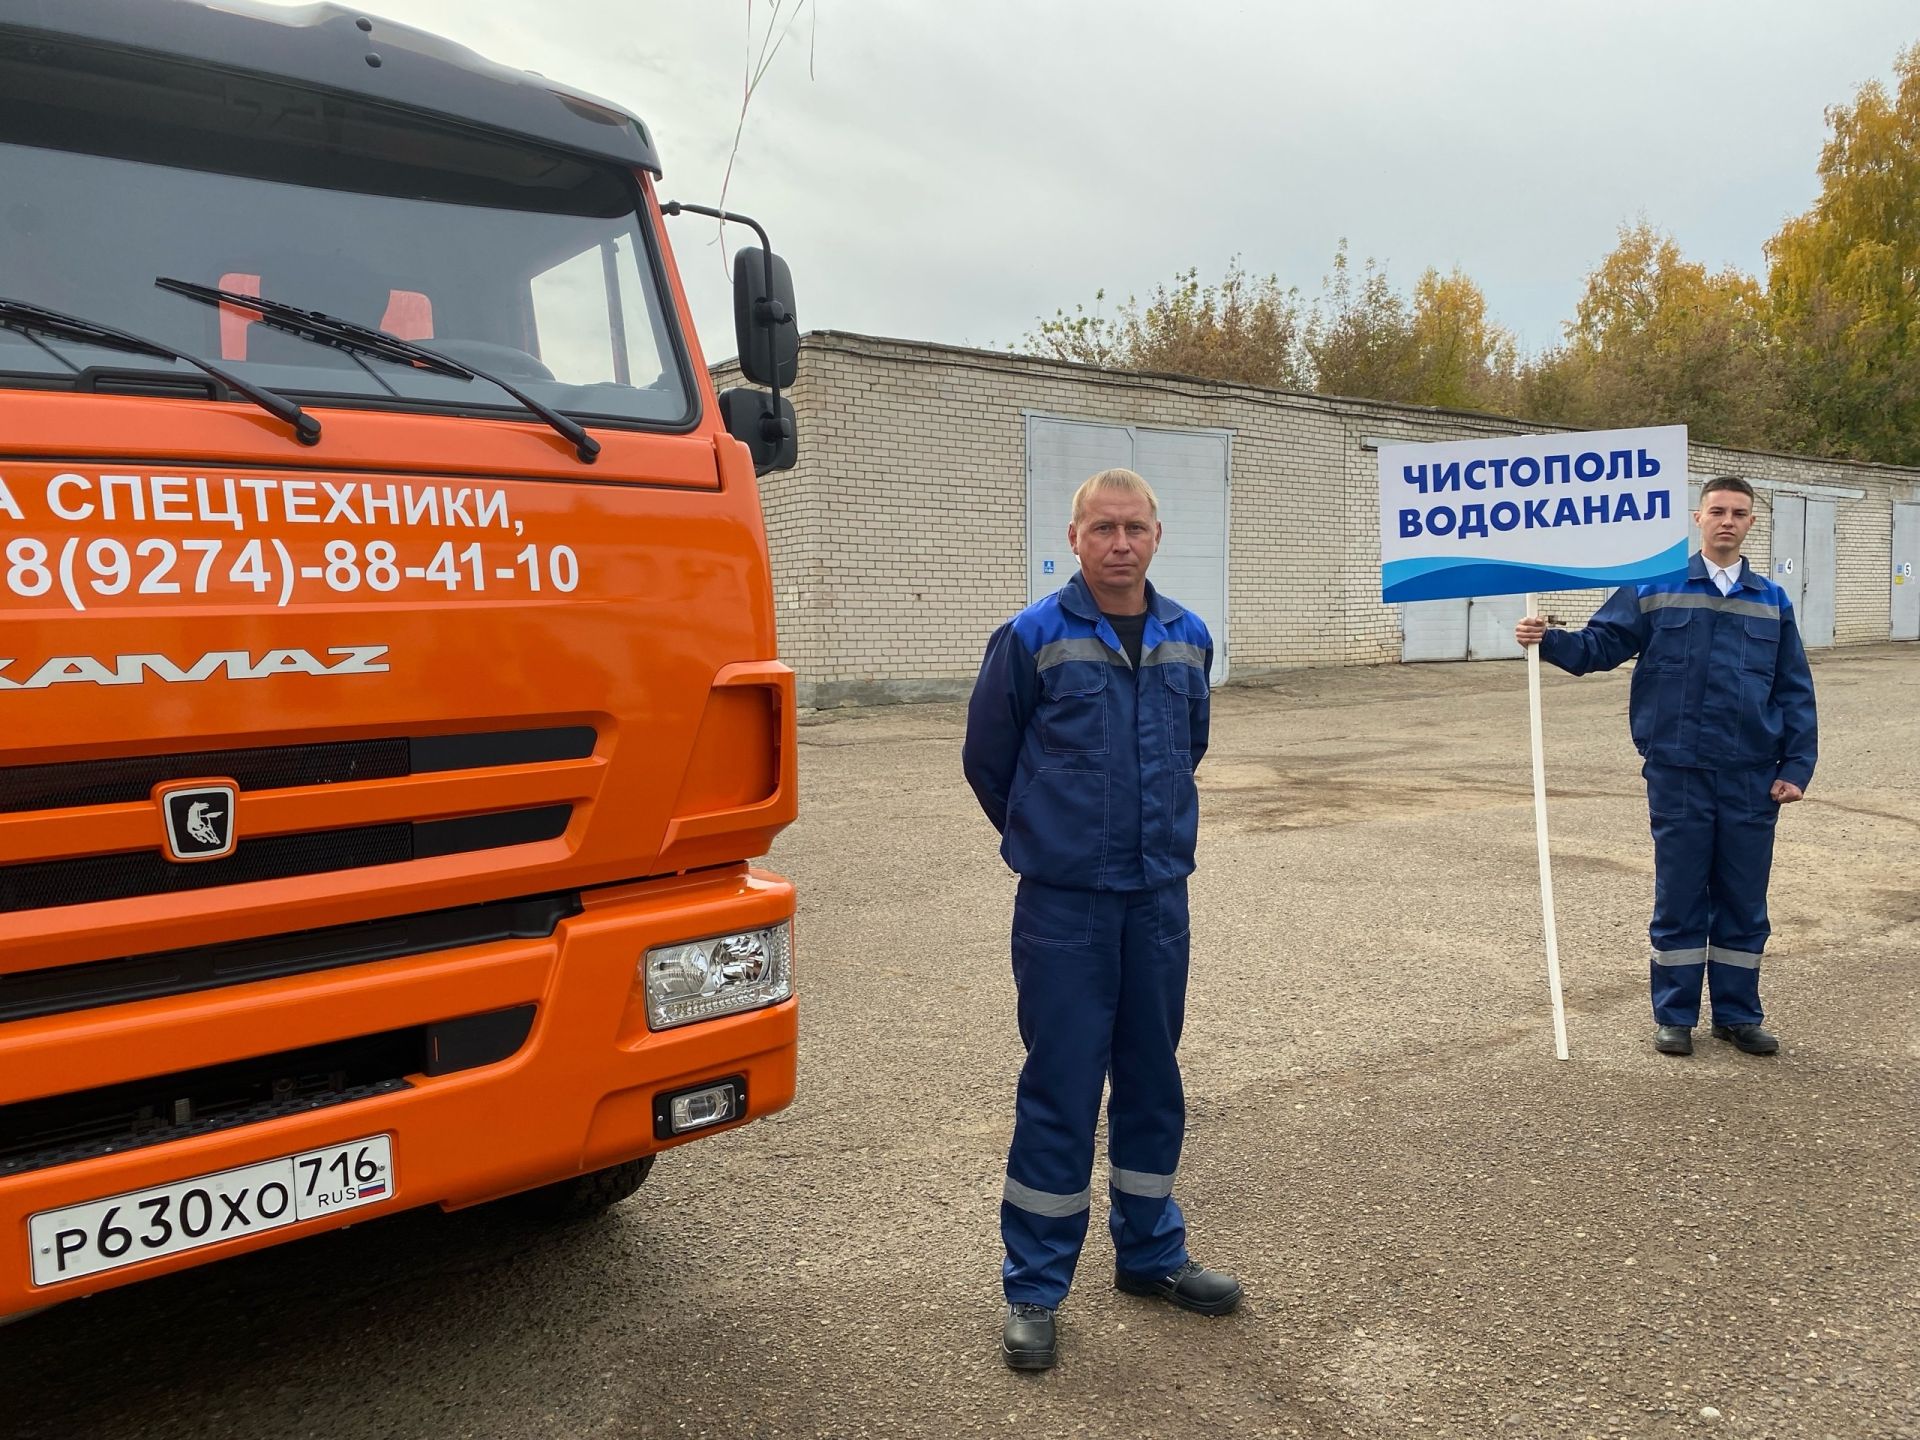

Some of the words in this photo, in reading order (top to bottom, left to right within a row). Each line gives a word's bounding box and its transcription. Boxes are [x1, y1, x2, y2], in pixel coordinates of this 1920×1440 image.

[1403, 449, 1661, 494] ЧИСТОПОЛЬ
[46, 473, 524, 536] СПЕЦТЕХНИКИ,
[1399, 490, 1671, 539] ВОДОКАНАЛ
[6, 537, 580, 611] 8(9274)-88-41-10
[299, 1146, 378, 1197] 716
[317, 1187, 356, 1208] RUS
